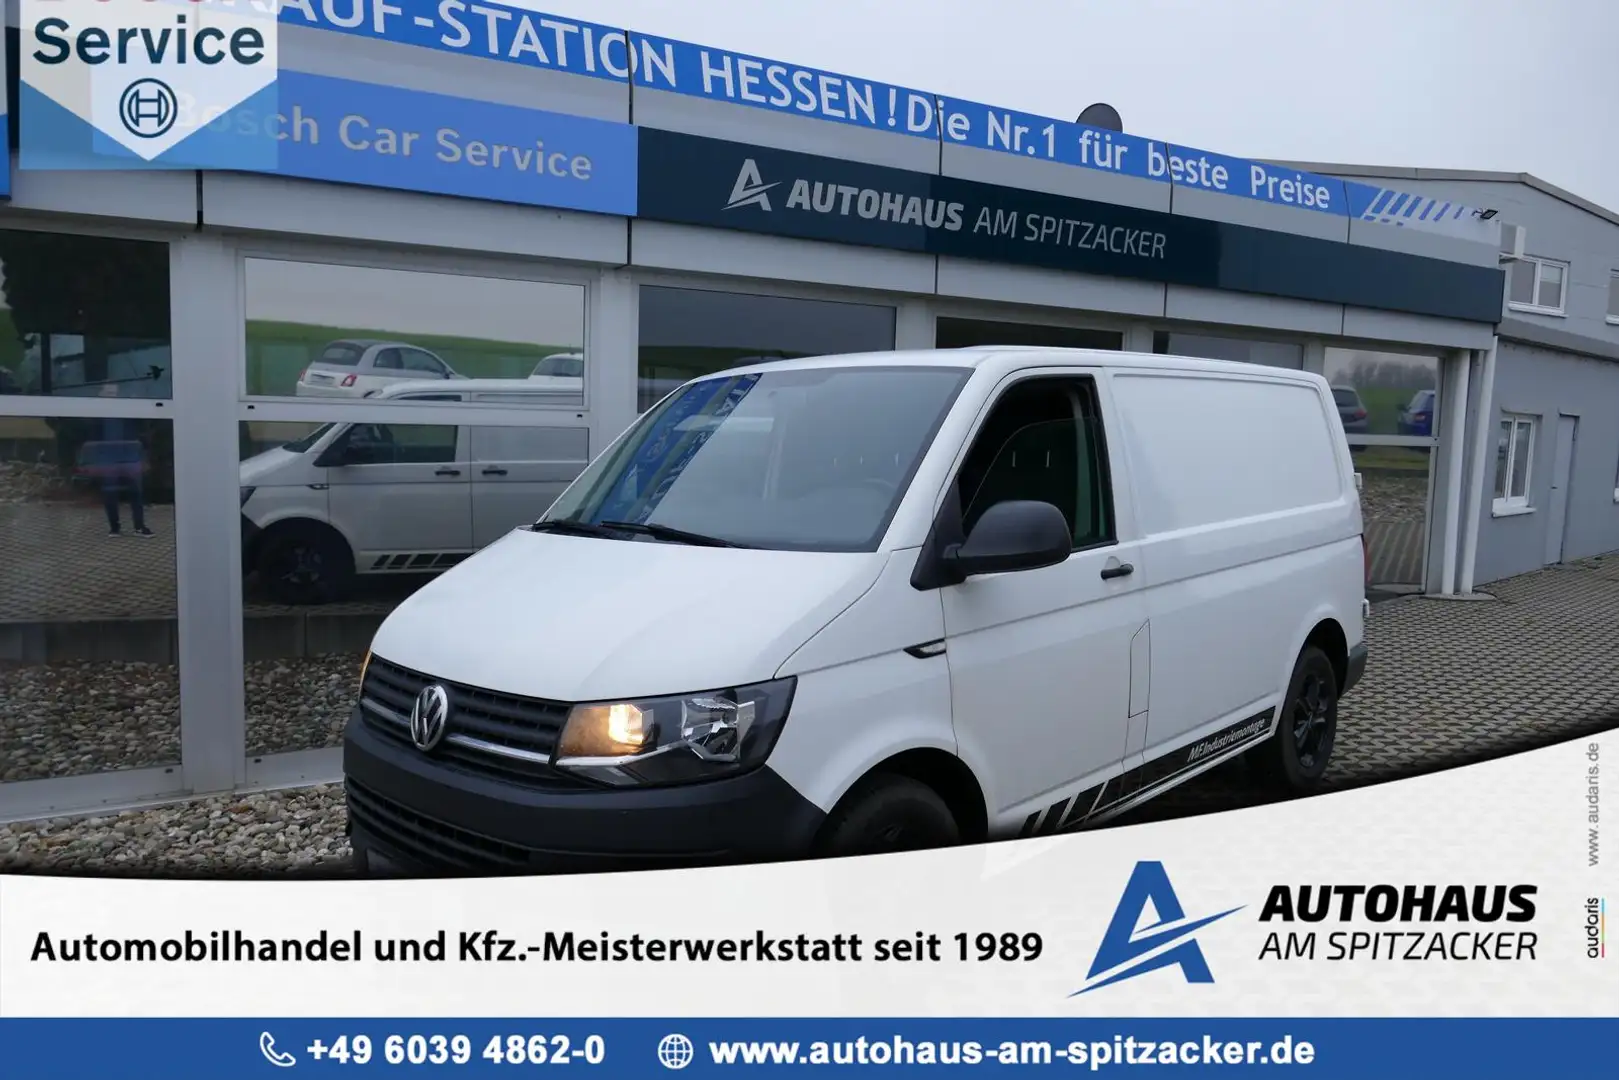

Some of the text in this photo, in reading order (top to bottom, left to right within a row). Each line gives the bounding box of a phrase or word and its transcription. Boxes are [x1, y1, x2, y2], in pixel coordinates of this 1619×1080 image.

[338, 114, 420, 156] Car
[436, 128, 593, 180] Service
[907, 89, 970, 141] Die
[988, 112, 1056, 158] Nr.1
[1079, 130, 1129, 171] für
[1147, 141, 1229, 190] beste
[1250, 166, 1330, 210] Preise
[786, 178, 1167, 259] AUTOHAUS AM SPITZACKER
